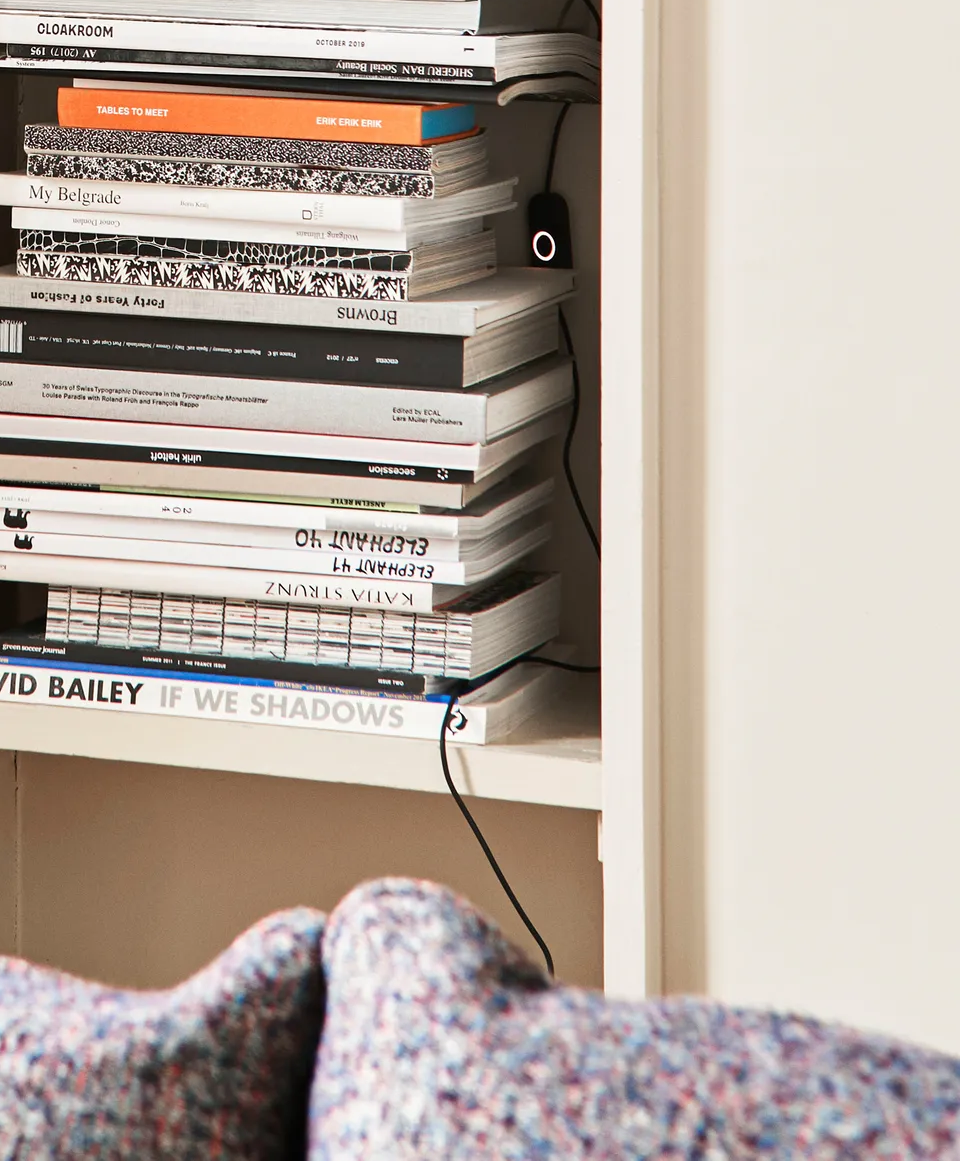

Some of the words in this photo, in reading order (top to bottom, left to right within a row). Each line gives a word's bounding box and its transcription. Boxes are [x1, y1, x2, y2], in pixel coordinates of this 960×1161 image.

[36, 22, 114, 38] CLOAKROOM
[315, 38, 347, 47] OCTOBER
[348, 39, 366, 48] 2019
[30, 46, 46, 56] 195
[50, 47, 79, 59] (2017)
[81, 49, 97, 58] AV
[335, 60, 368, 73] Beauty
[369, 63, 397, 74] Social
[402, 65, 425, 76] BAN
[427, 67, 474, 78] SHIGERU
[96, 105, 130, 116] TABLES
[131, 106, 144, 116] TO
[144, 108, 169, 118] MEET
[315, 116, 337, 126] ERIK
[338, 117, 360, 127] ERIK
[361, 118, 382, 128] ERIK
[29, 185, 53, 201] My
[57, 185, 122, 206] Belgrade
[99, 218, 121, 228] Conor
[296, 229, 325, 240] Tillmans
[326, 230, 359, 242] Wolfgang
[30, 291, 77, 304] Fashion
[80, 293, 93, 303] of
[95, 295, 130, 307] Years
[133, 297, 165, 309] Forty
[337, 306, 398, 325] Browns
[51, 383, 67, 391] Years
[94, 386, 131, 396] Typographic
[132, 388, 162, 396] Discourse
[169, 390, 180, 398] the
[179, 400, 199, 408] Rappo
[392, 407, 413, 415] Edited
[423, 409, 441, 417] ECAL
[429, 417, 463, 426] Publishers
[180, 453, 202, 463] ulrik
[368, 464, 416, 477] secession
[330, 497, 353, 507] REYLE
[354, 499, 386, 508] ANSELM
[295, 528, 322, 549] 40
[327, 529, 429, 556] ELEPHANT
[355, 557, 434, 579] ELEPHANT
[265, 581, 343, 601] STRUNZ
[351, 587, 414, 606] KATJA
[2, 643, 21, 653] green
[21, 644, 42, 653] soccer
[42, 645, 66, 655] journal
[48, 676, 144, 705] BAILEY
[160, 685, 183, 708] IF
[194, 688, 238, 714] WE
[250, 693, 405, 729] SHADOWS
